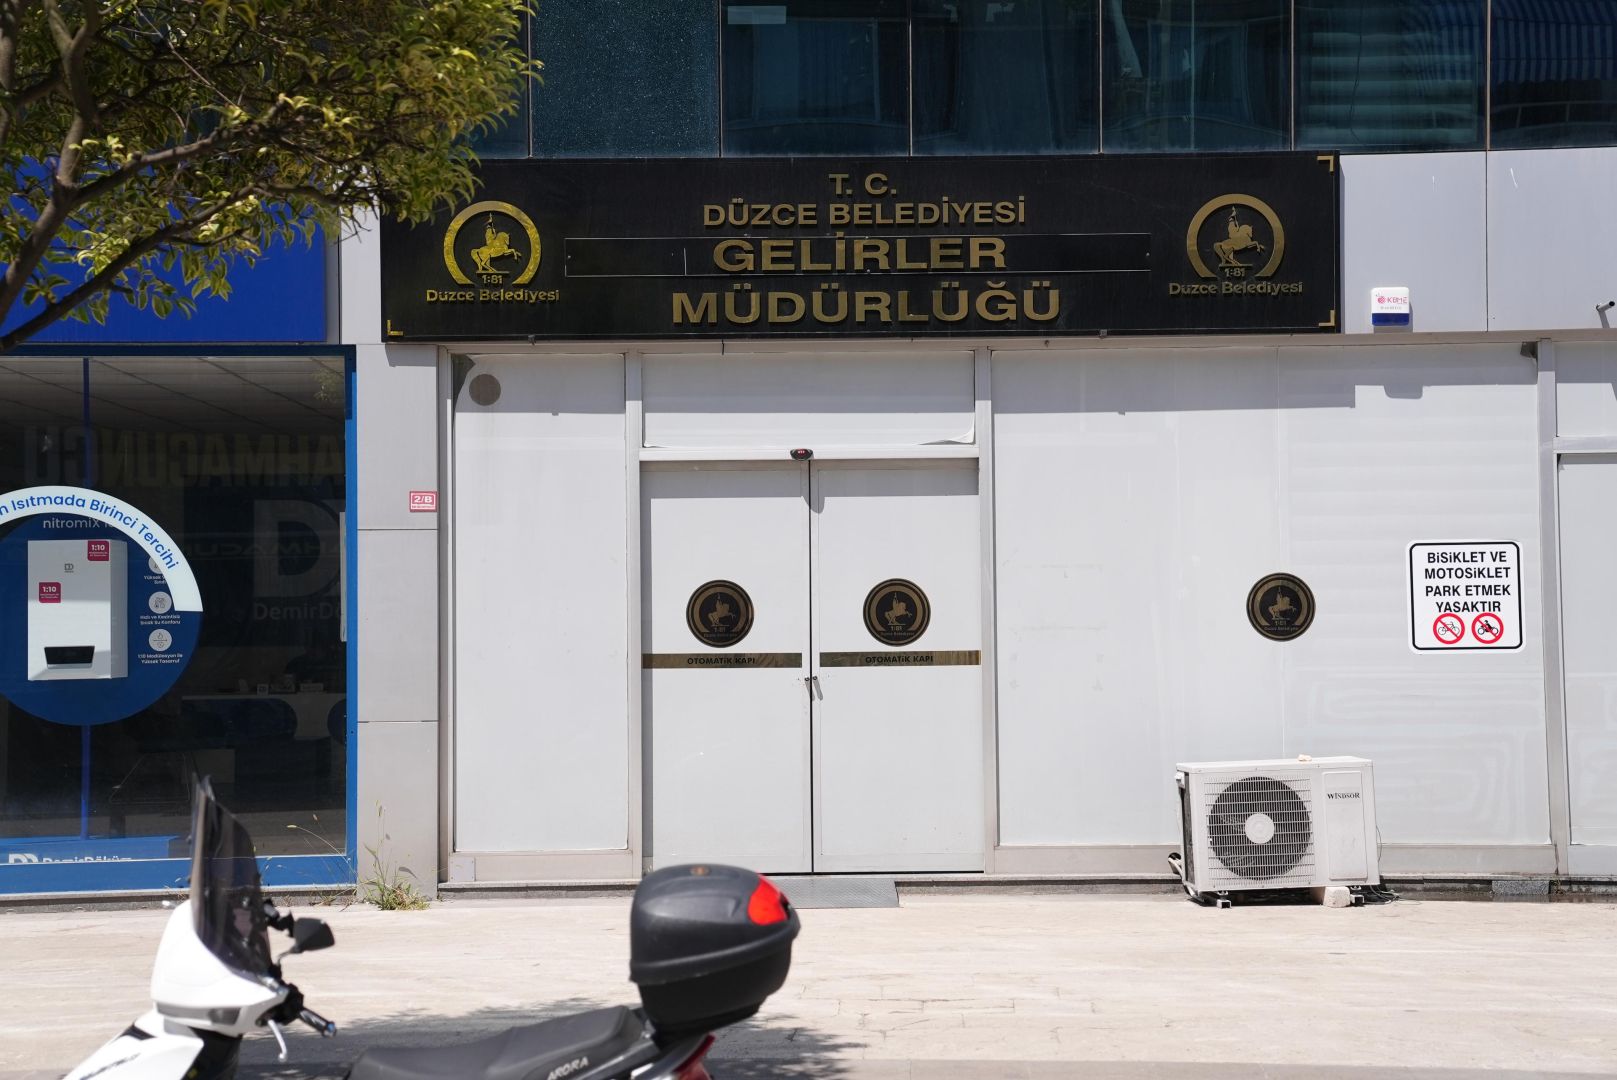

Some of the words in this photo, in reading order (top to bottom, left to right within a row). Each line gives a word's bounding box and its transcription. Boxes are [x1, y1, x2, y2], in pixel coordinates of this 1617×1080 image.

[828, 173, 853, 195] T.
[864, 173, 897, 195] C.
[703, 197, 818, 226] DÜZCE
[829, 195, 1025, 225] BELEDİYESİ
[713, 231, 1007, 272] GELİRLER
[426, 289, 475, 302] Düzce
[479, 288, 561, 303] Belediyesi
[1168, 282, 1217, 295] Düzce
[1221, 280, 1304, 296] Belediyesi
[672, 281, 1060, 324] MÜDÜRLÜĞÜ
[43, 517, 101, 529] nitromix
[12, 494, 87, 511] Isıtmada
[90, 500, 138, 528] Birinci
[138, 524, 179, 570] Tercihi
[1490, 551, 1507, 562] VE
[1425, 585, 1461, 596] PARK
[1465, 585, 1511, 596] ETMEK
[1435, 601, 1501, 612] YASAKTIR
[913, 655, 933, 664] KAPI
